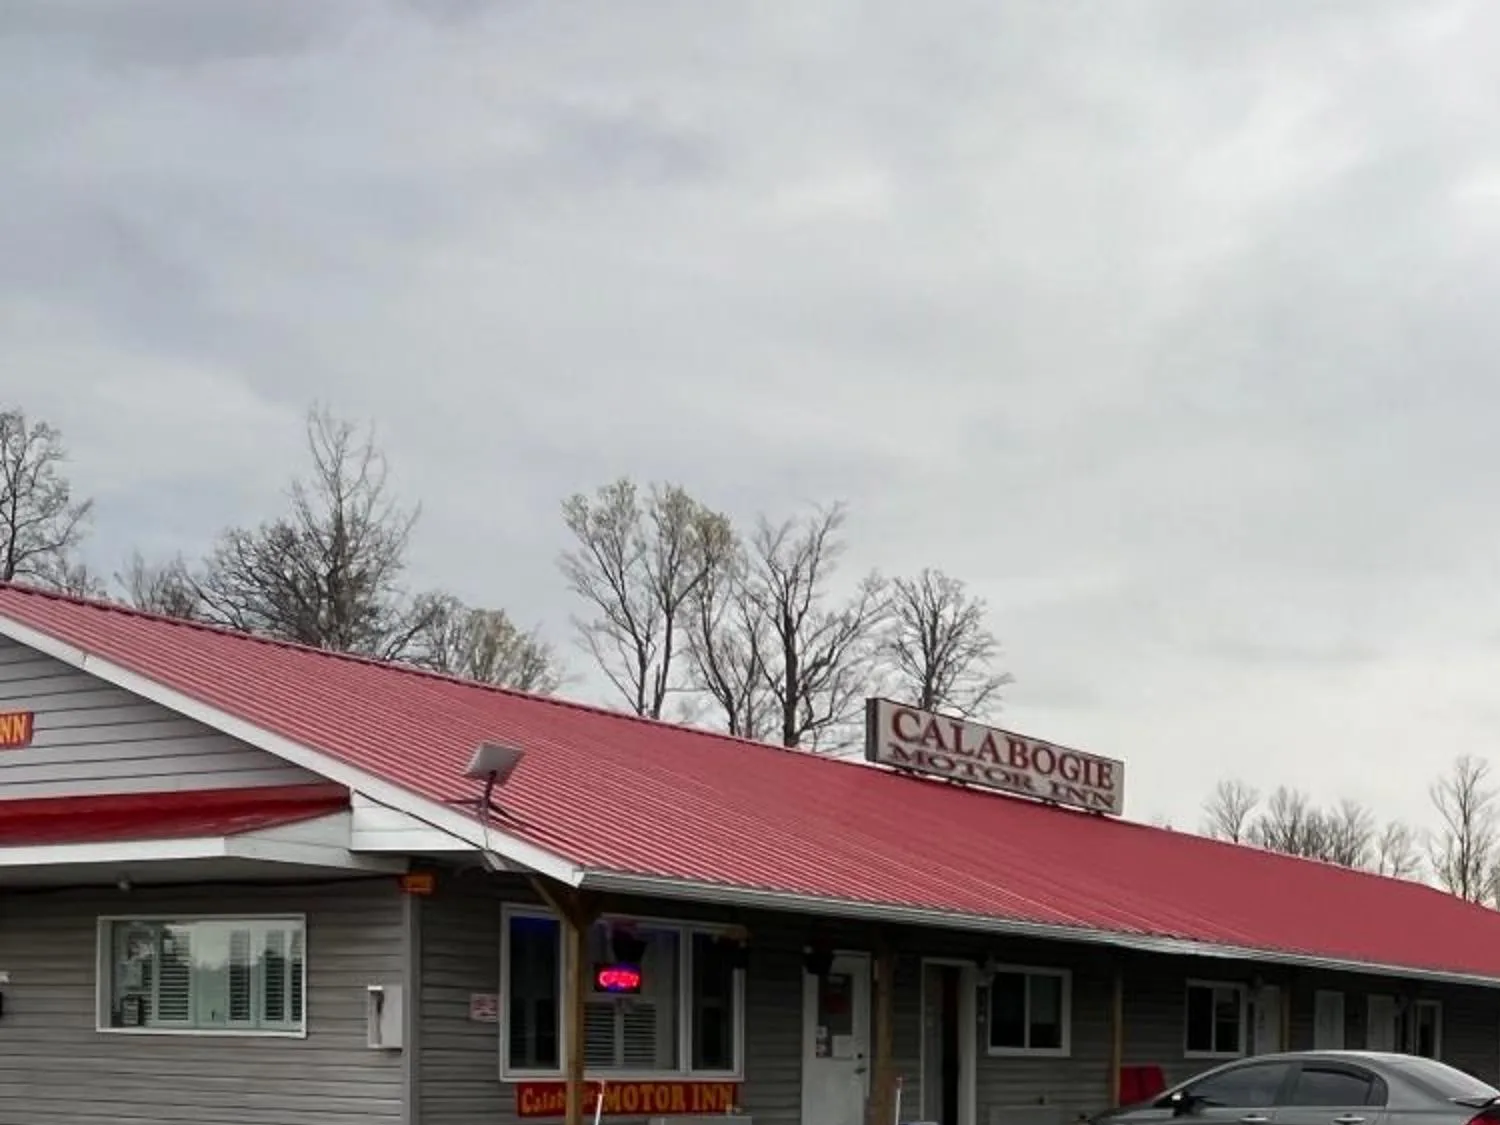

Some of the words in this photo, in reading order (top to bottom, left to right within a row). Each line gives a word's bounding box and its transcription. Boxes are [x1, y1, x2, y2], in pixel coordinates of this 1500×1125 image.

[892, 708, 1114, 790] CALABOGIE
[887, 742, 1035, 791] MOTOR
[1048, 779, 1116, 808] INN
[599, 971, 639, 987] OPEN
[604, 1084, 686, 1112] MOTOR
[691, 1083, 733, 1112] INN
